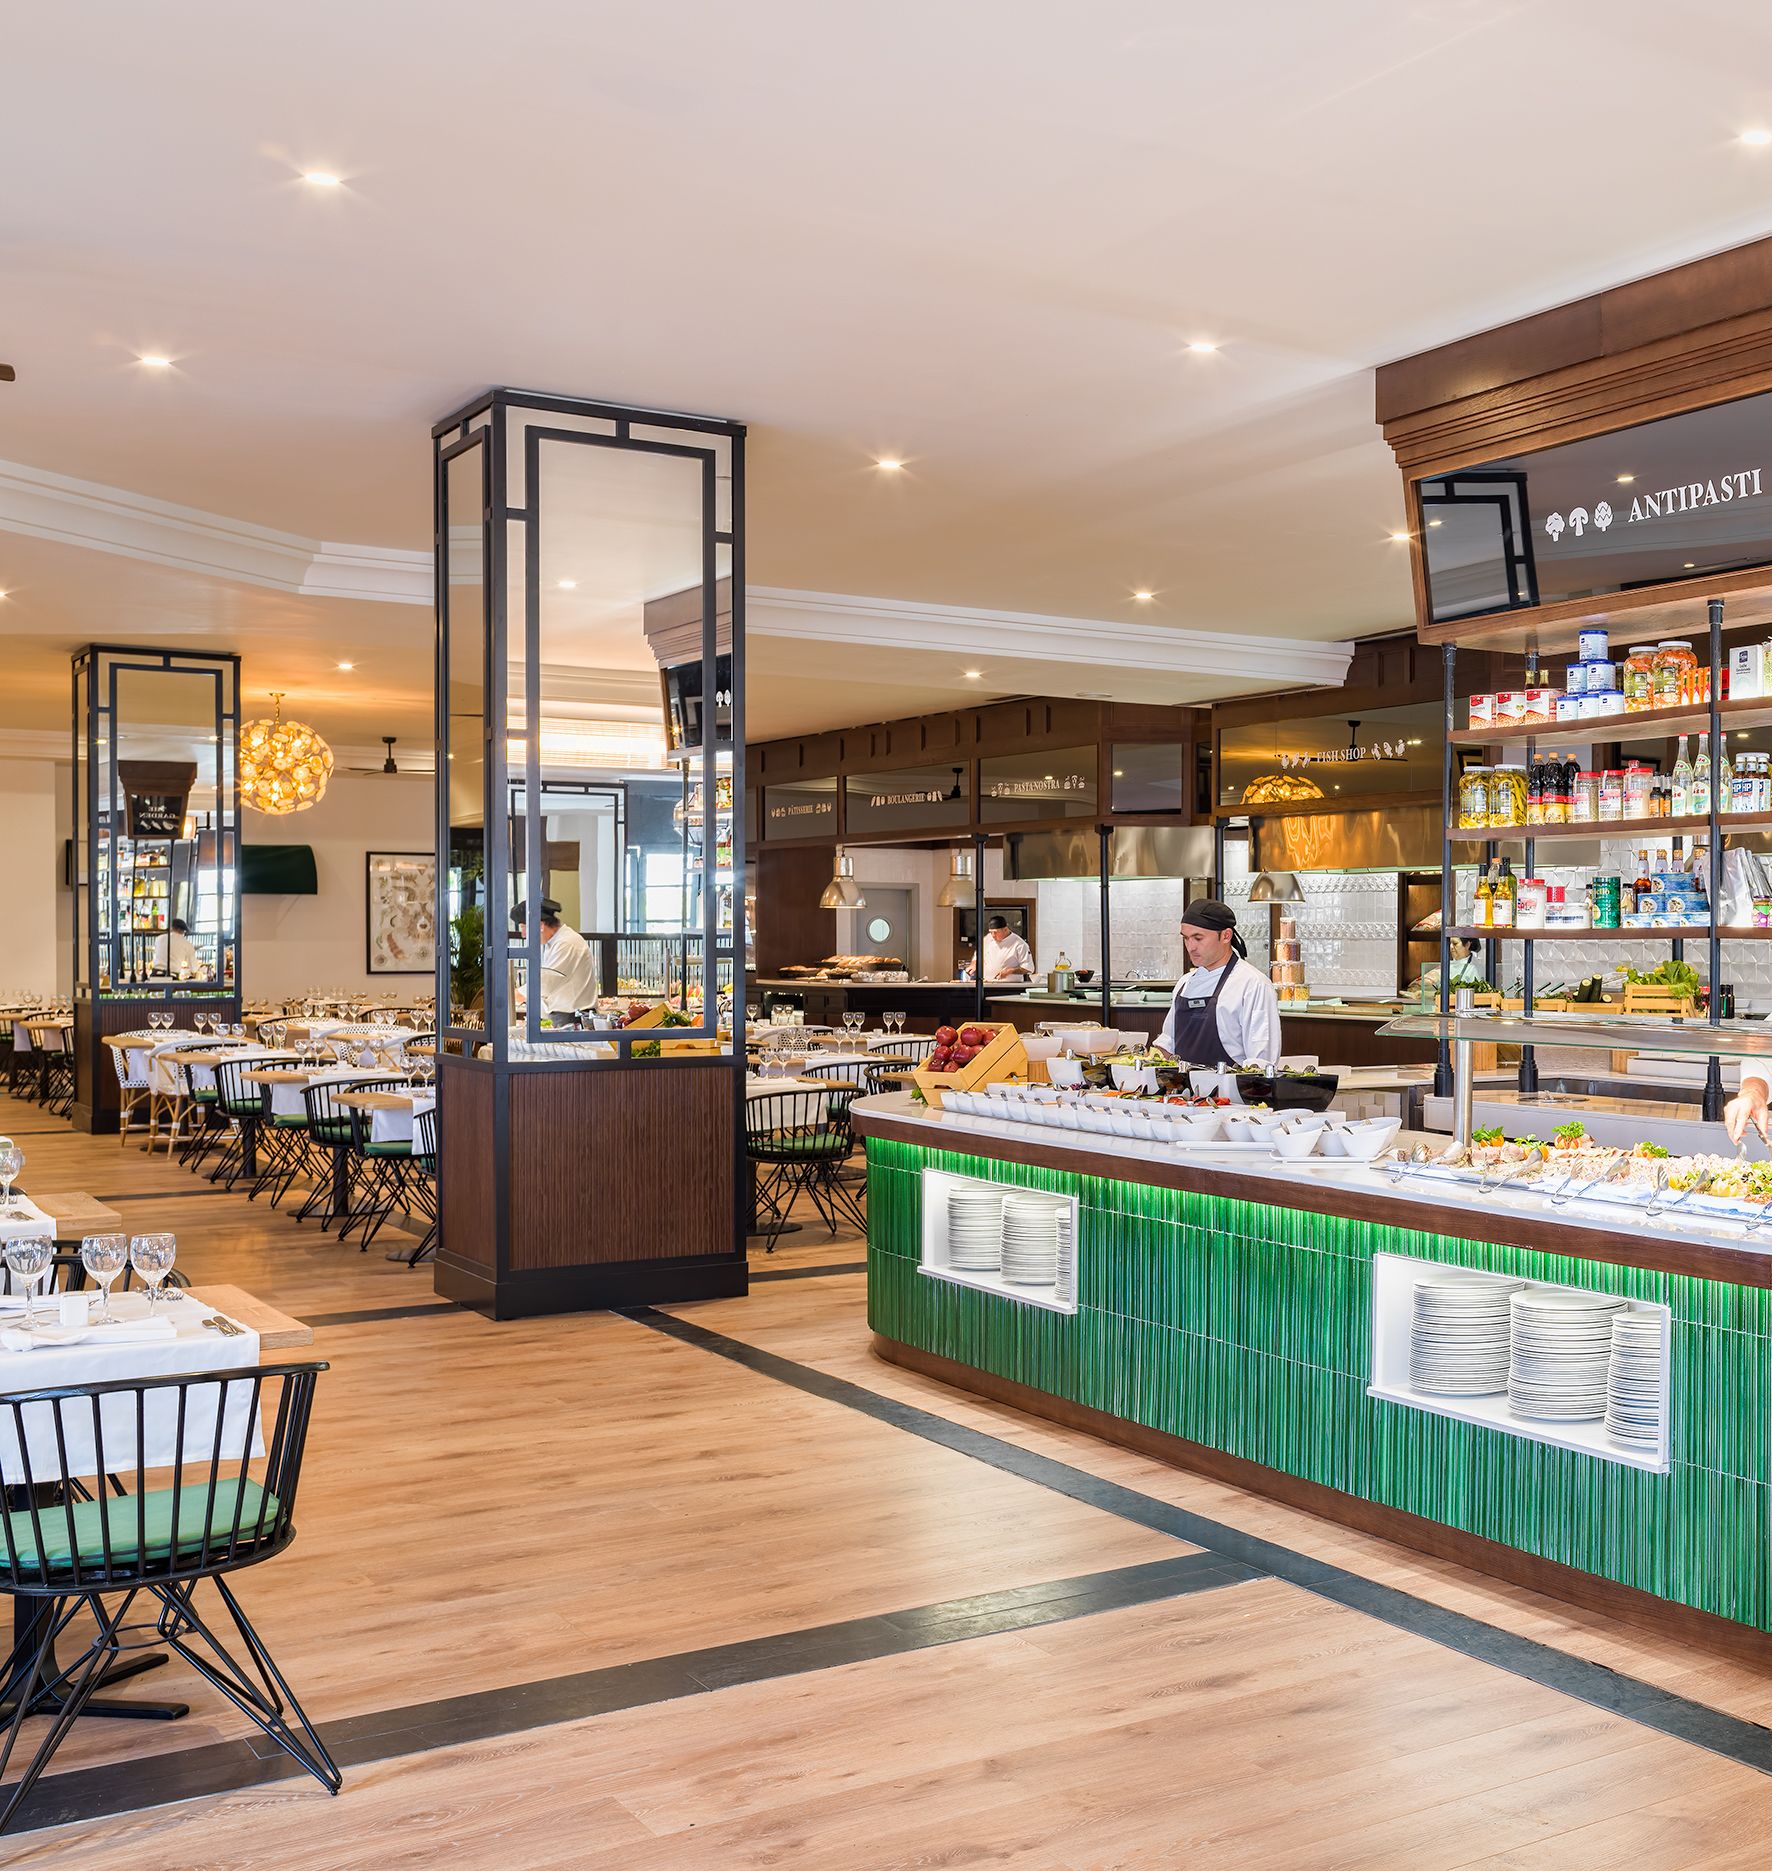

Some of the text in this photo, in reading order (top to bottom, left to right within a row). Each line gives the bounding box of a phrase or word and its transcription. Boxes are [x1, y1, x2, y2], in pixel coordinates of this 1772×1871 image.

[1627, 468, 1763, 524] ANTIPASTI
[1316, 747, 1367, 763] FISH SHOP
[887, 794, 925, 804] BOULANGERIE
